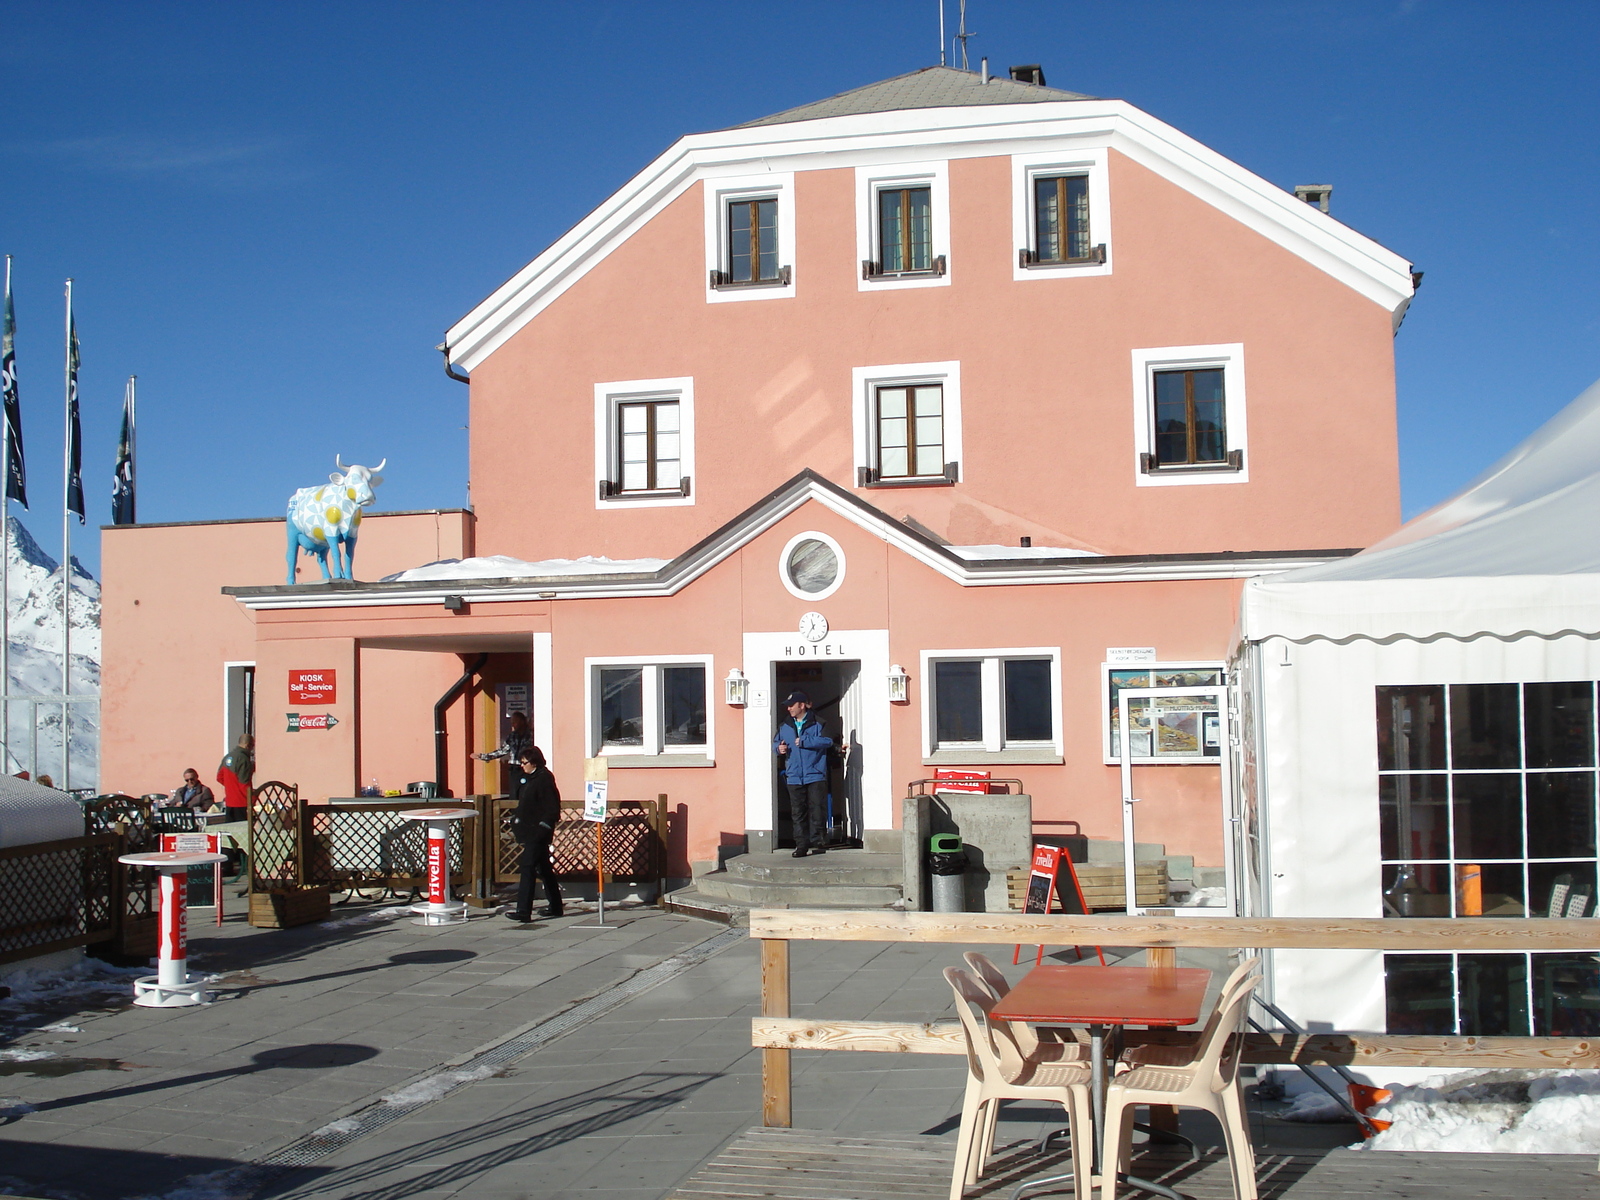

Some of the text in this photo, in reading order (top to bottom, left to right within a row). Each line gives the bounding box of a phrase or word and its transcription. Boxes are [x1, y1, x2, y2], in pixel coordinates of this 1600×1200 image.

[785, 644, 845, 656] HOTEL
[299, 674, 324, 682] KIOSK
[307, 683, 333, 691] Service
[1035, 852, 1053, 868] rivella
[428, 846, 440, 897] rivella
